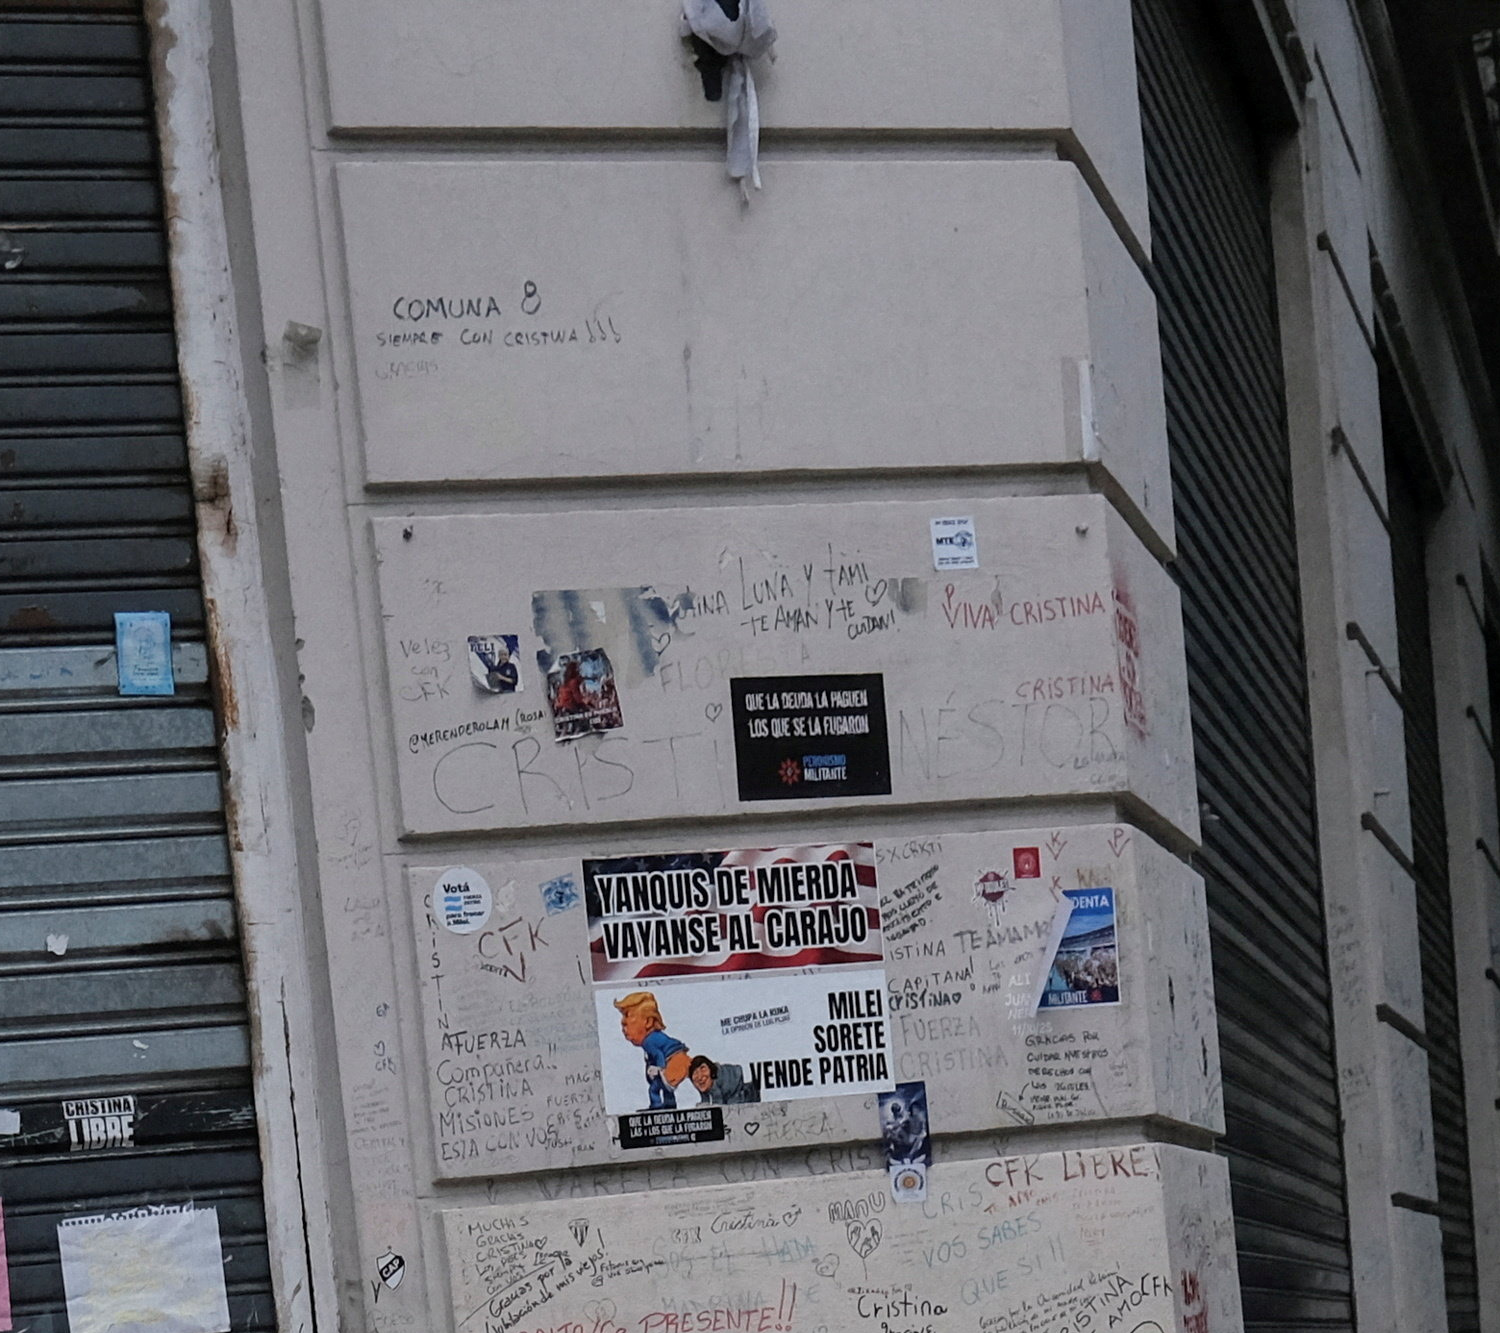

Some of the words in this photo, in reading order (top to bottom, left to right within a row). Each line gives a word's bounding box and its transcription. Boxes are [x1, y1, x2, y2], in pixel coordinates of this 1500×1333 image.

[393, 296, 501, 321] COMUNA
[521, 280, 542, 315] 8
[376, 330, 444, 346] SIEMPRE
[460, 327, 493, 345] CON
[504, 327, 579, 347] CRISTINA
[739, 556, 794, 611] LUNA
[741, 615, 769, 636] TE
[774, 604, 819, 633] AMAN
[1010, 591, 1107, 626] CRISTINA
[401, 681, 452, 702] CFK
[745, 693, 765, 711] QUE
[766, 692, 780, 710] LA
[781, 691, 814, 709] DEUDA
[815, 691, 829, 708] LA
[830, 689, 868, 708] PAGUEN
[1016, 671, 1115, 701] CRISTINA
[748, 718, 769, 738] LOS
[771, 718, 791, 737] QUE
[792, 716, 807, 736] SE
[808, 716, 822, 736] LA
[823, 714, 870, 736] FUGARON
[804, 766, 848, 781] MILITANTE
[442, 882, 470, 894] Votá
[595, 868, 711, 916] YANQUIS
[714, 866, 752, 907] DE
[755, 860, 858, 904] MIERDA
[479, 916, 549, 959] CFK
[602, 913, 721, 961] VAYANSE
[728, 911, 761, 951] AL
[765, 904, 868, 948] CARAJO
[827, 989, 883, 1020] MILEI
[888, 992, 955, 1011] CRISTINA
[720, 1018, 732, 1027] ME
[758, 1011, 769, 1019] LA
[813, 1021, 886, 1053] SORETE
[750, 1057, 814, 1090] VENDE
[820, 1052, 889, 1085] PATRIA
[65, 1096, 133, 1117] CRISTINA
[444, 1078, 534, 1109] CRISTINA
[68, 1115, 135, 1151] LIBRE
[629, 1117, 642, 1127] QUE
[643, 1116, 652, 1125] LA
[653, 1114, 675, 1124] DEUDA
[648, 1126, 660, 1136] LOS
[985, 1156, 1044, 1188] CFK
[828, 1191, 885, 1224] MANU
[711, 1211, 781, 1235] Cristina
[382, 1258, 401, 1278] CAP
[857, 1291, 948, 1319] Cristina
[1108, 1289, 1143, 1328] AMO
